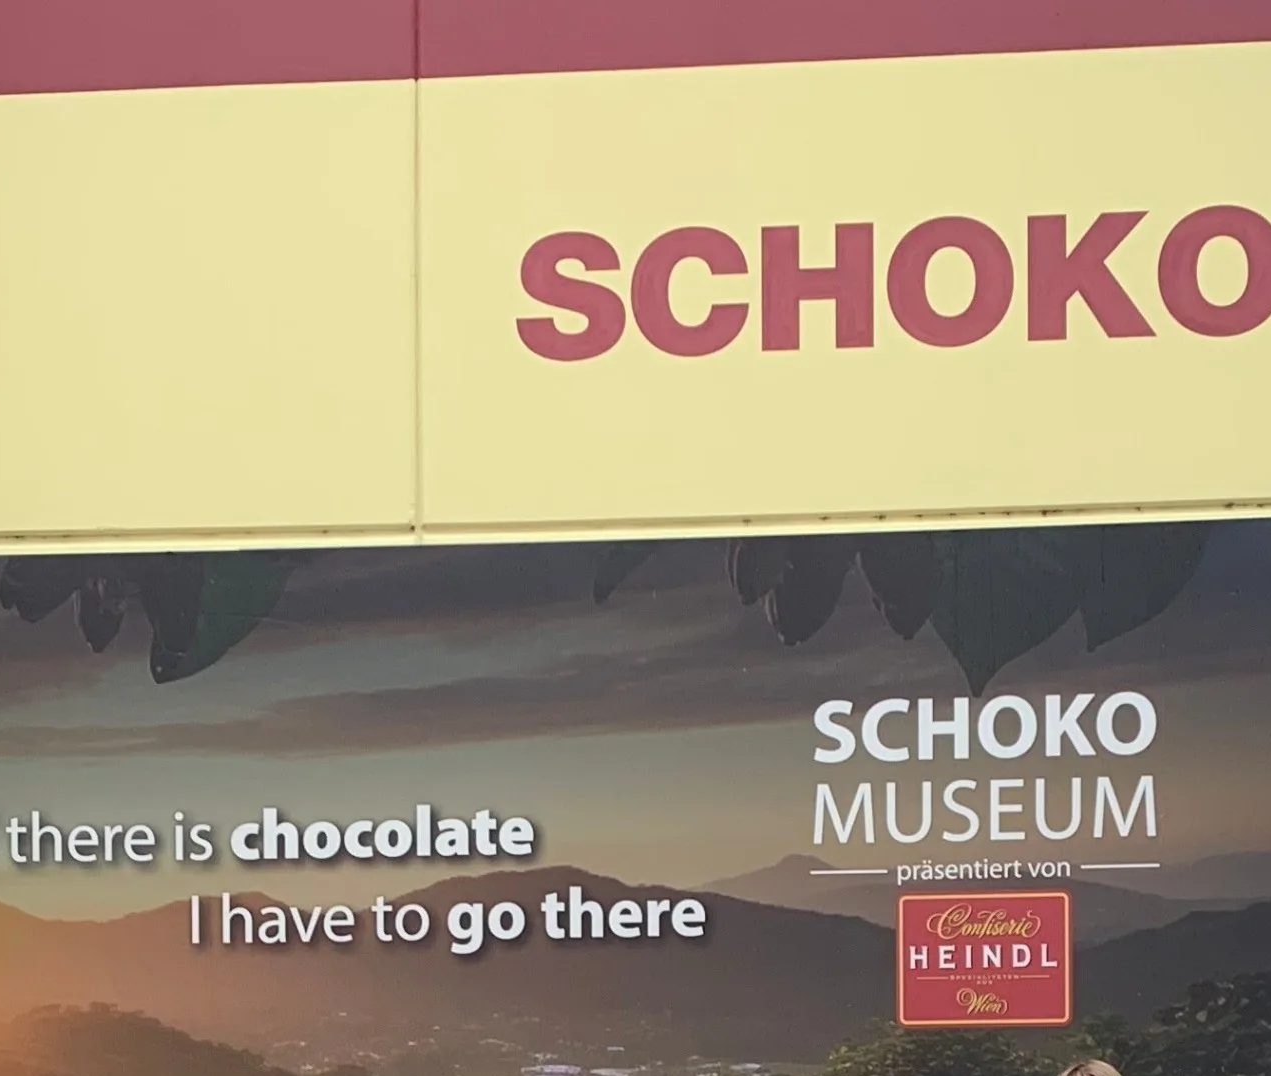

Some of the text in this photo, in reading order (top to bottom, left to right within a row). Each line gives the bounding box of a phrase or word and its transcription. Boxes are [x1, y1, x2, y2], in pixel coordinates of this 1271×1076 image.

[812, 691, 1157, 764] SCHOKO
[5, 810, 156, 863] there
[173, 811, 214, 862] is
[230, 804, 535, 860] chocolate
[812, 775, 1157, 844] MUSEUM
[896, 859, 1072, 886] präsentiert von
[191, 886, 707, 955] I have to go there
[927, 903, 1041, 940] Confiserie
[909, 944, 1059, 970] HEINDL
[956, 987, 1008, 1016] Wien
